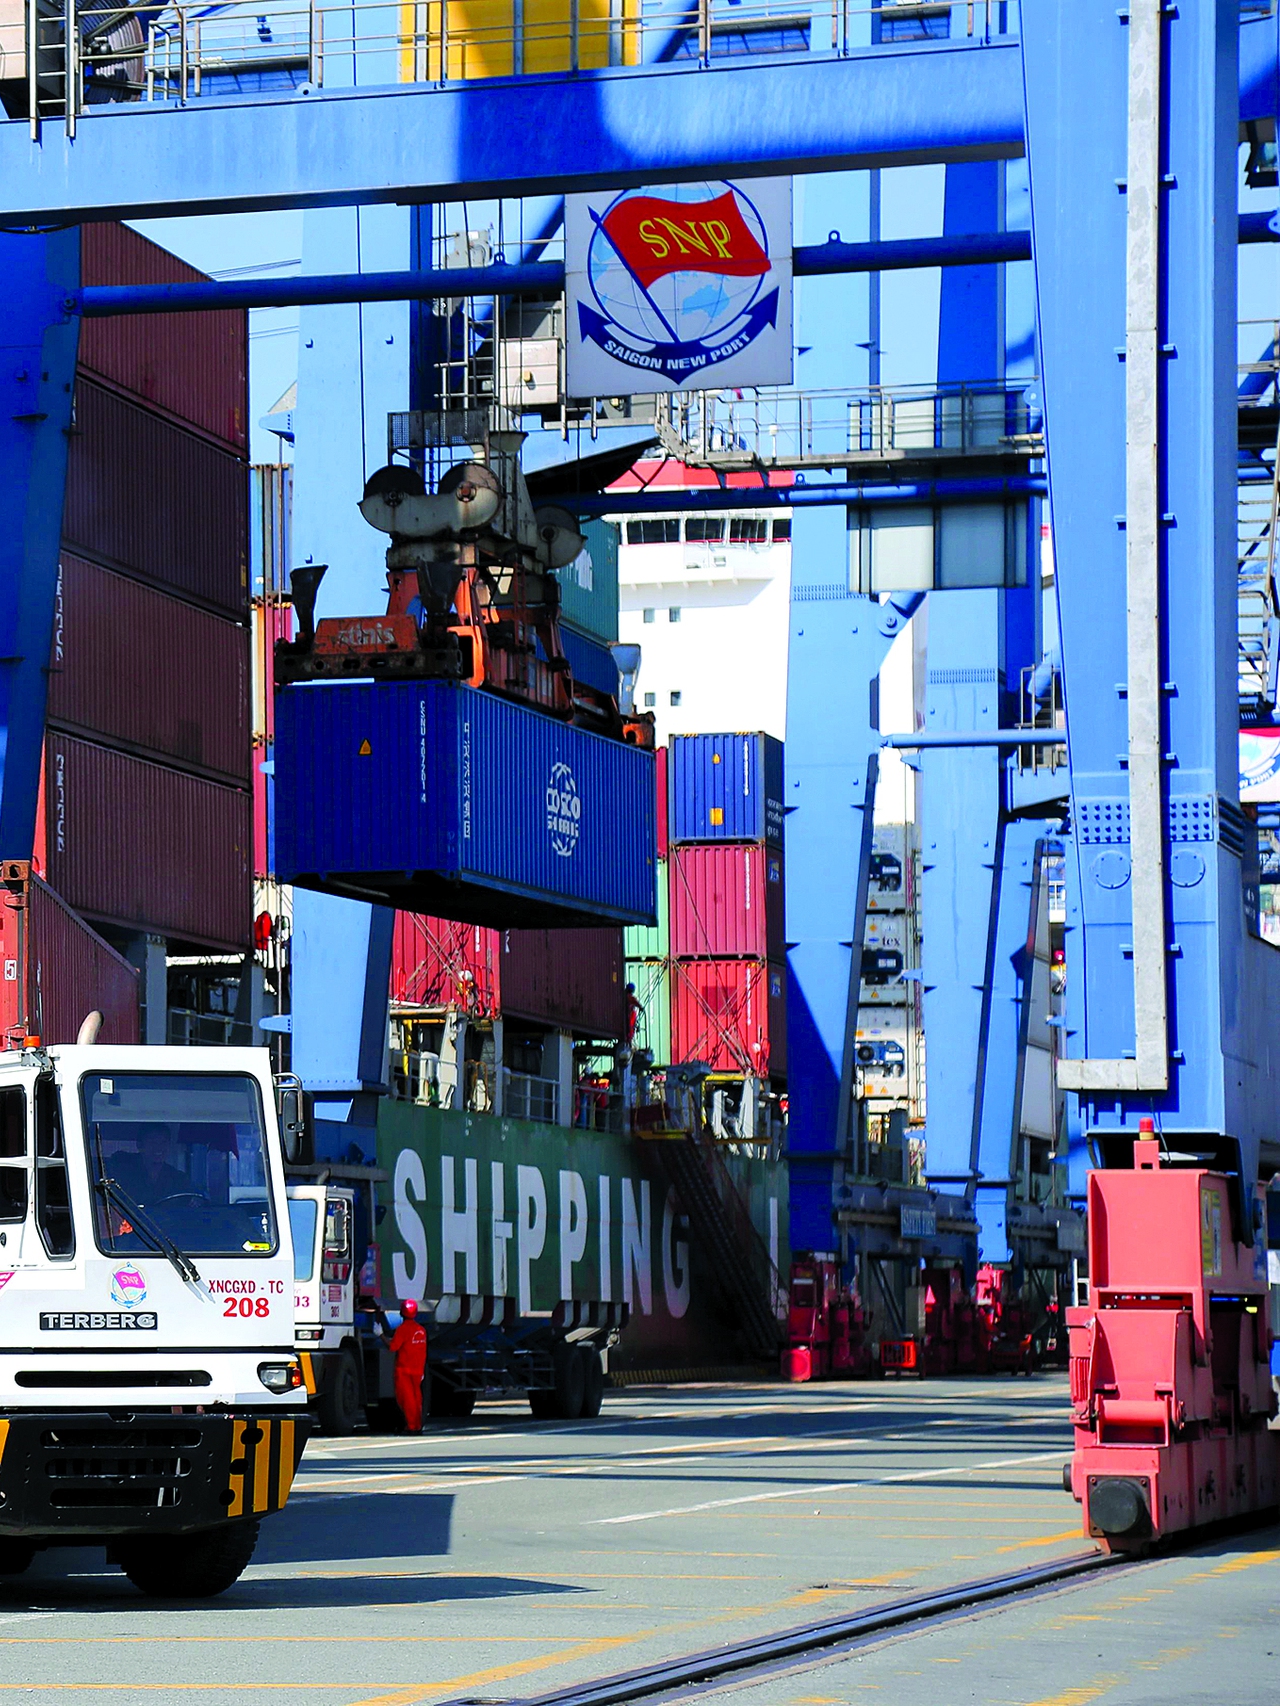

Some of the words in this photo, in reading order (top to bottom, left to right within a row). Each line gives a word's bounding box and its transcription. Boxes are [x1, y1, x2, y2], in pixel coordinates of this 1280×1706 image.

[639, 217, 733, 259] SNP
[603, 339, 663, 370] SAIGON
[666, 356, 708, 371] NEW
[710, 331, 752, 362] PORT
[4, 960, 17, 981] 5
[391, 1148, 692, 1320] SHIPPING
[208, 1279, 257, 1294] XNCGXD
[268, 1279, 284, 1294] TC
[222, 1296, 270, 1318] 208
[41, 1313, 157, 1329] TERBERG
